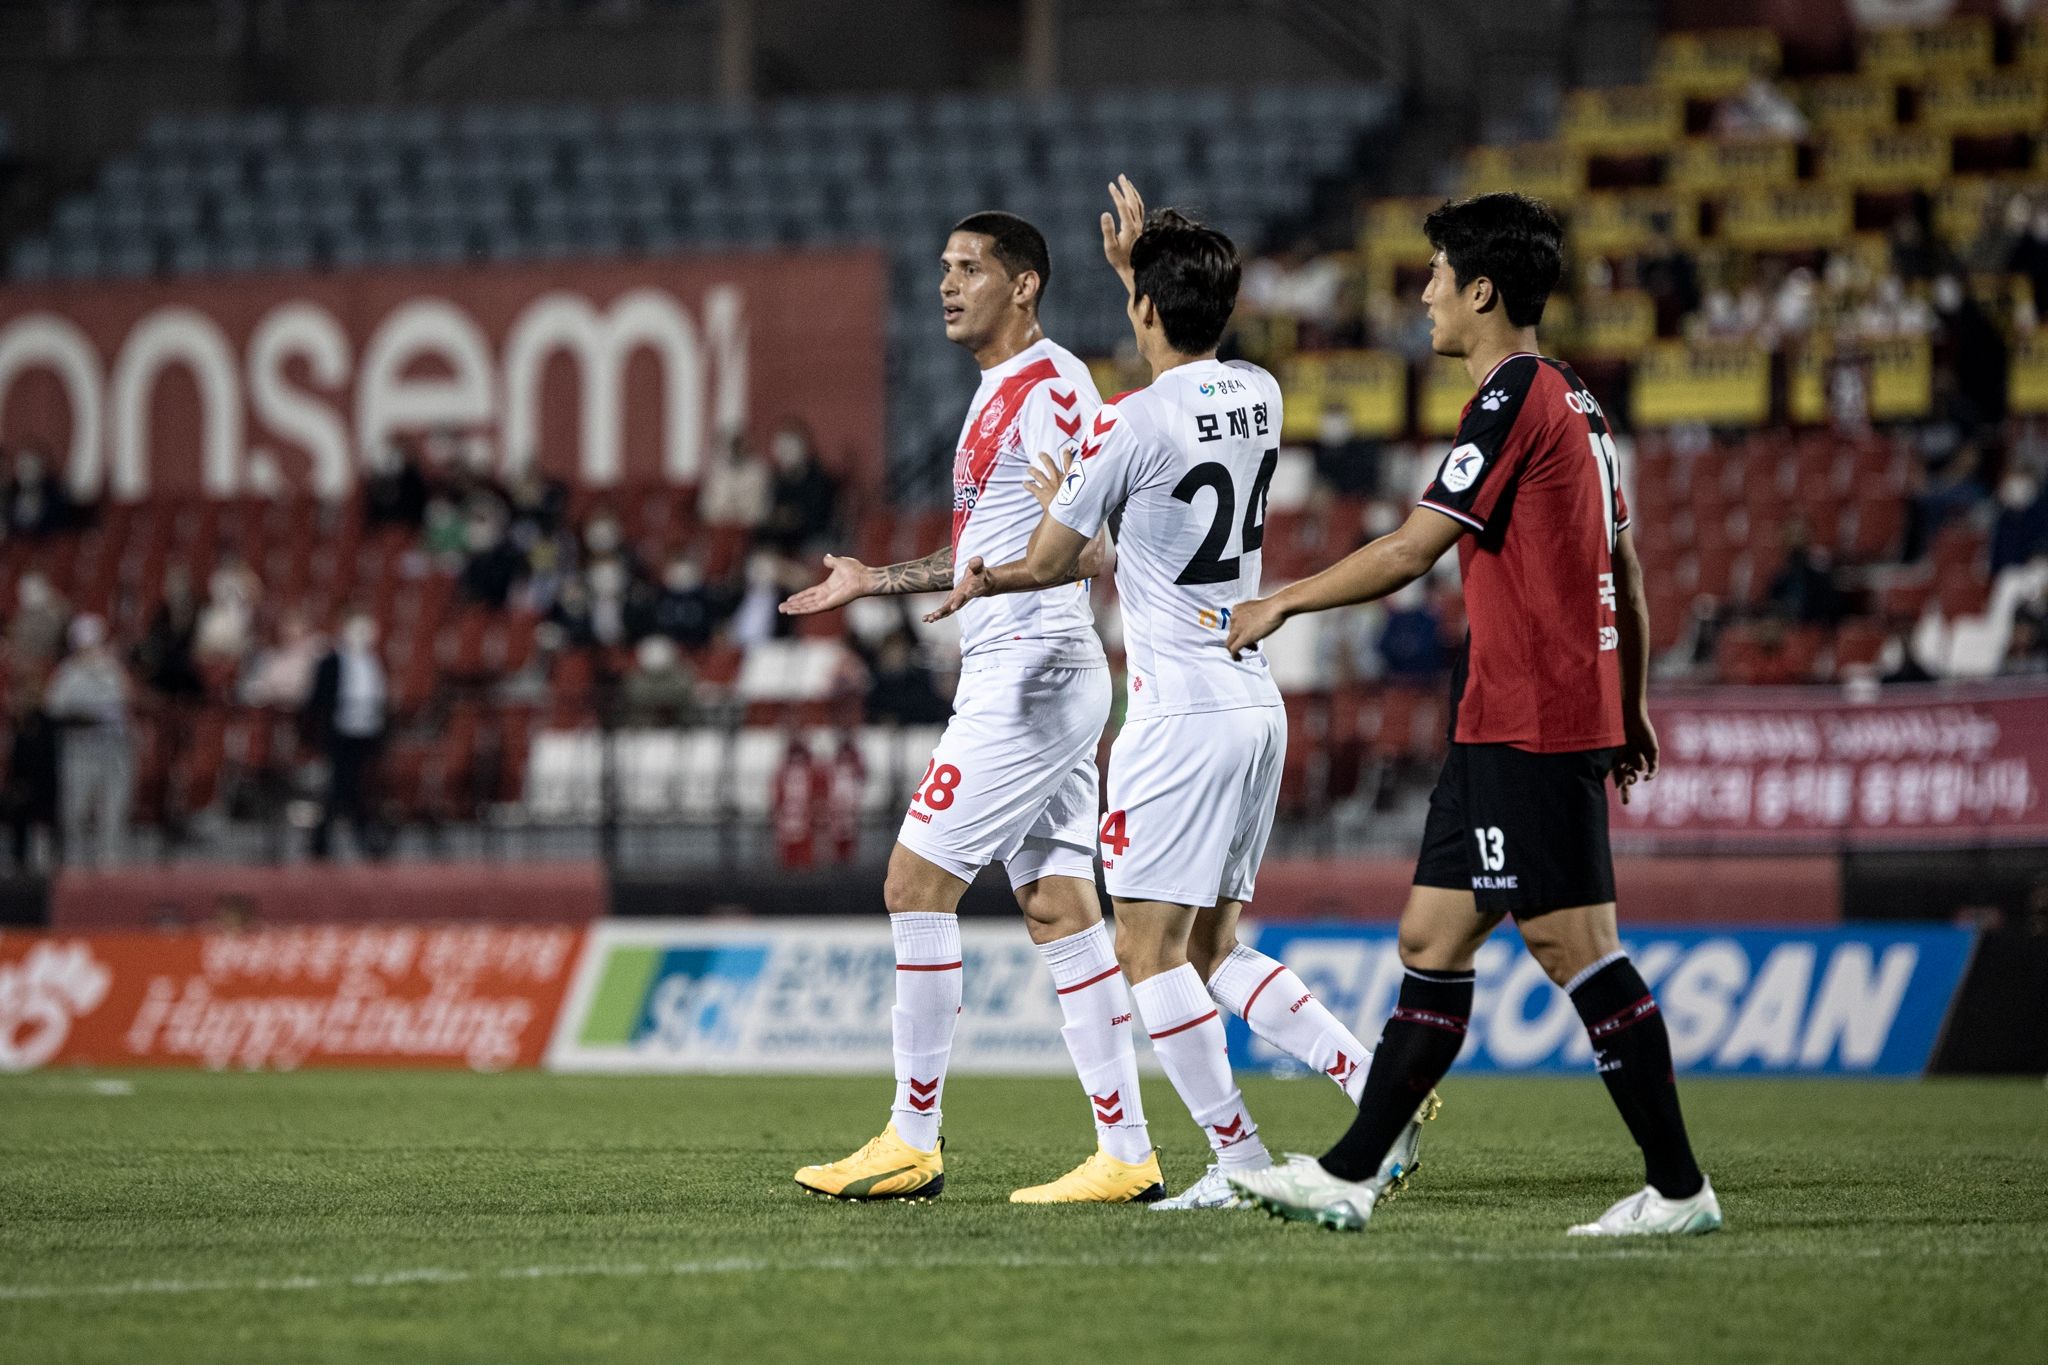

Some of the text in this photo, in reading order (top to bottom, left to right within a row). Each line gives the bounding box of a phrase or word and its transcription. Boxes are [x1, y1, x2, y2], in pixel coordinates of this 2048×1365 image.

[1171, 448, 1278, 586] 24
[907, 807, 933, 825] ummel
[1474, 826, 1505, 871] 13
[1472, 875, 1518, 889] KELME
